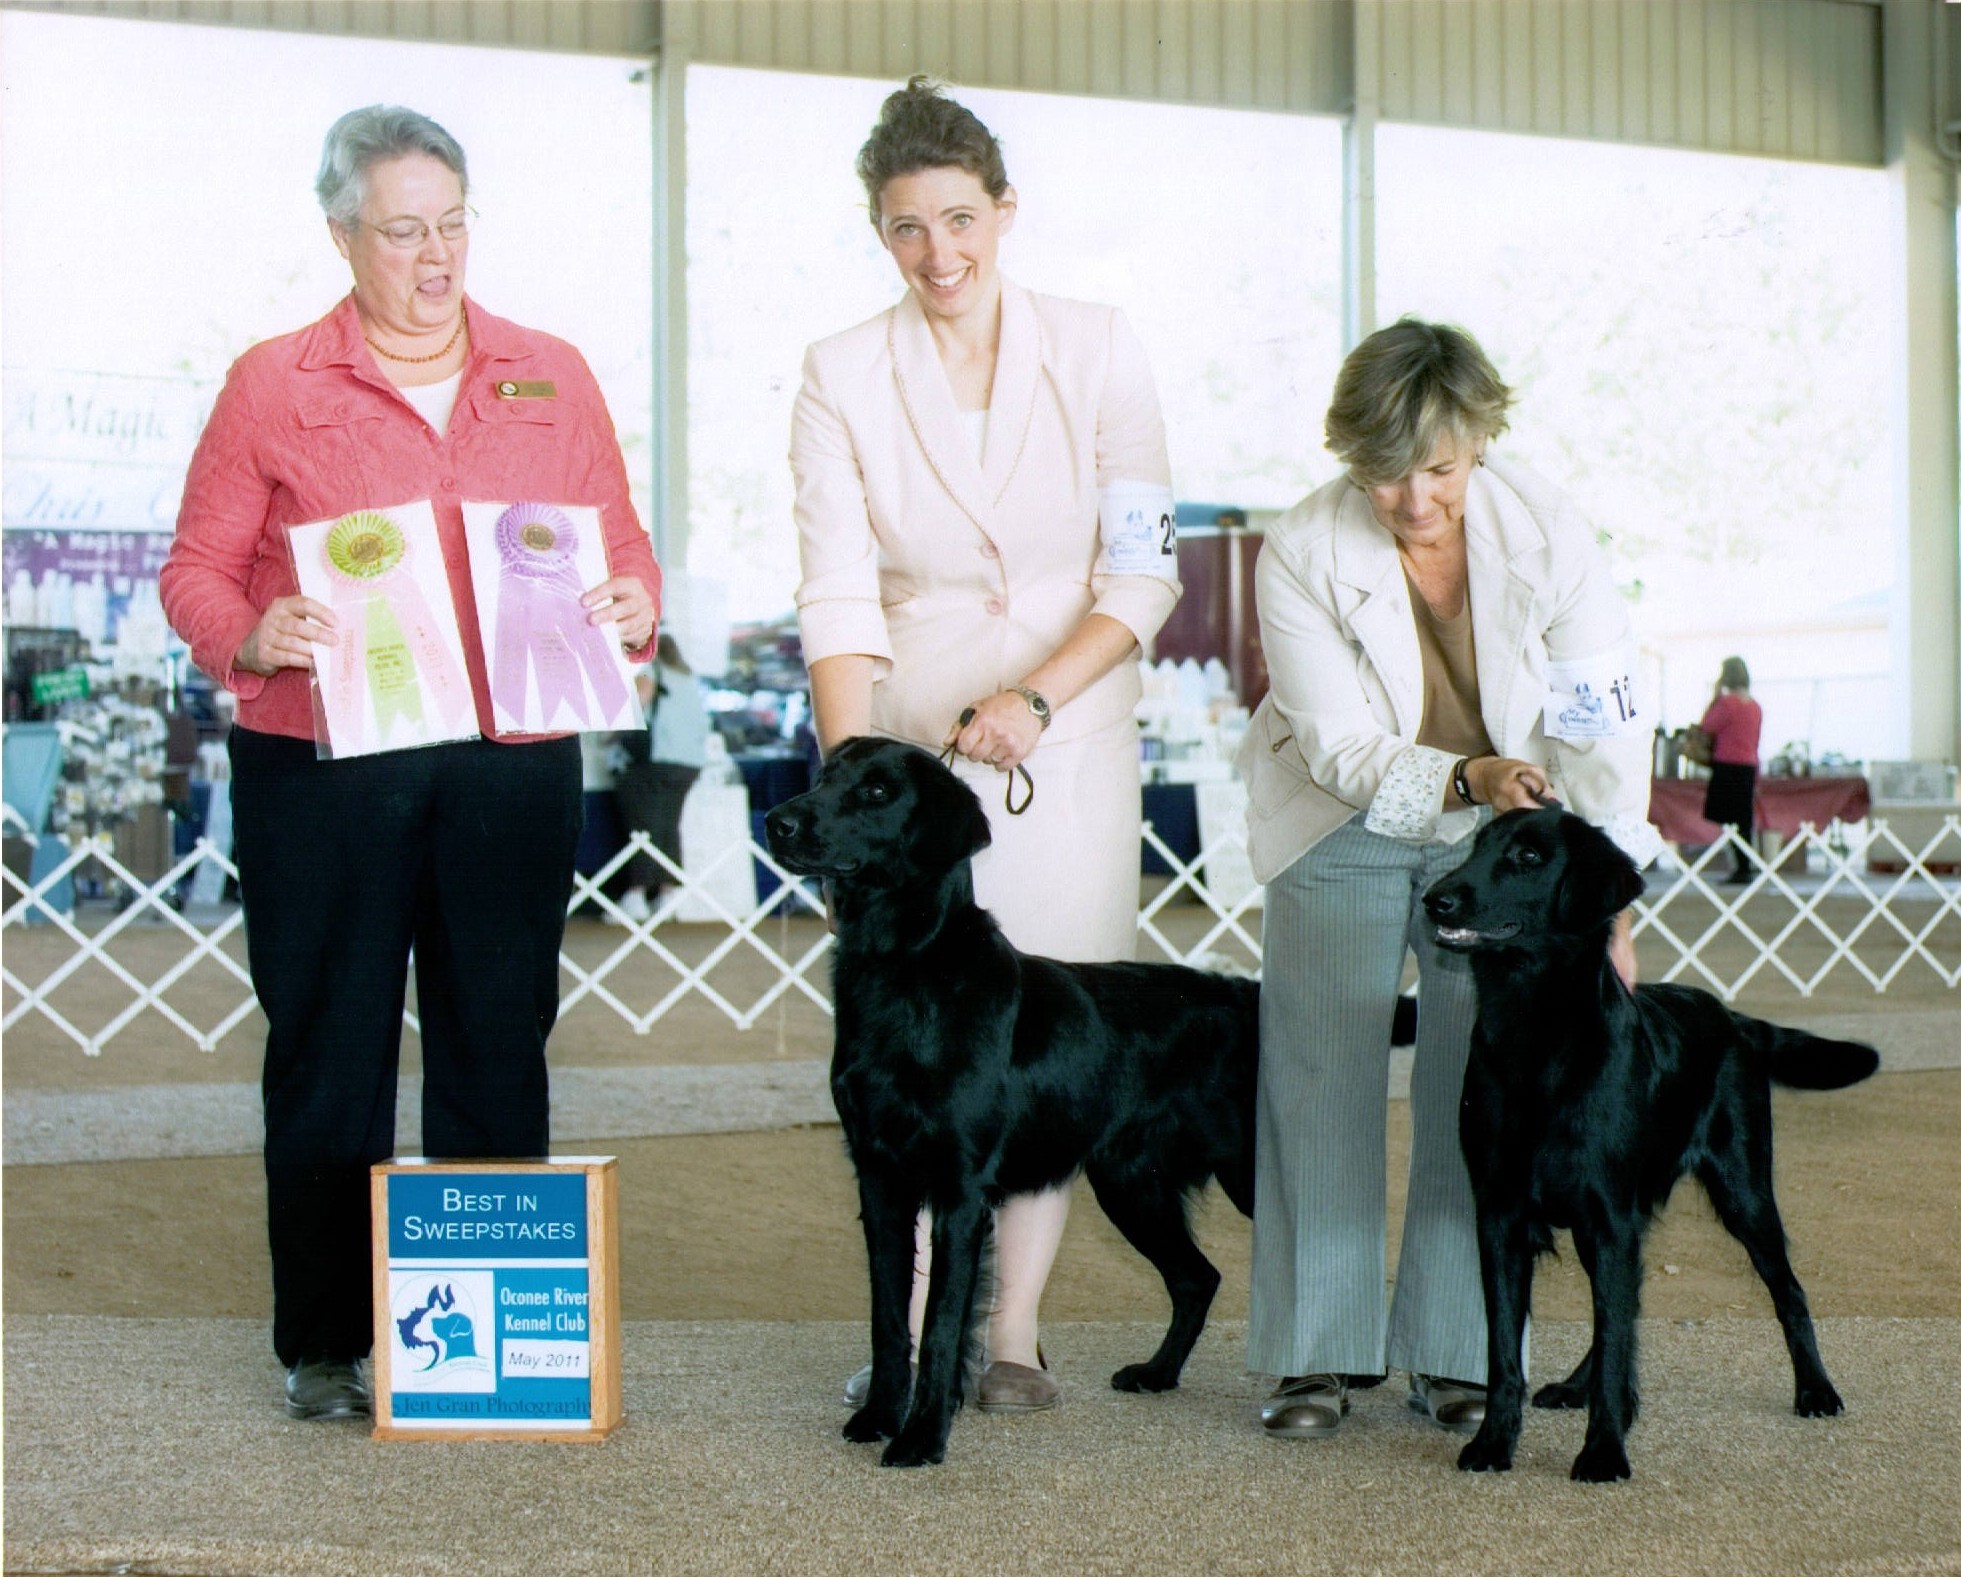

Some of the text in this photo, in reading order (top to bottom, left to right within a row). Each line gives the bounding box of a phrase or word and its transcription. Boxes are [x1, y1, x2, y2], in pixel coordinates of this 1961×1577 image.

[1609, 674, 1637, 722] 12
[500, 1286, 588, 1306] Oconee River
[504, 1311, 586, 1332] Kennel Club
[509, 1351, 580, 1369] May 2011
[402, 1396, 431, 1417] Jen
[436, 1396, 480, 1414] Gran
